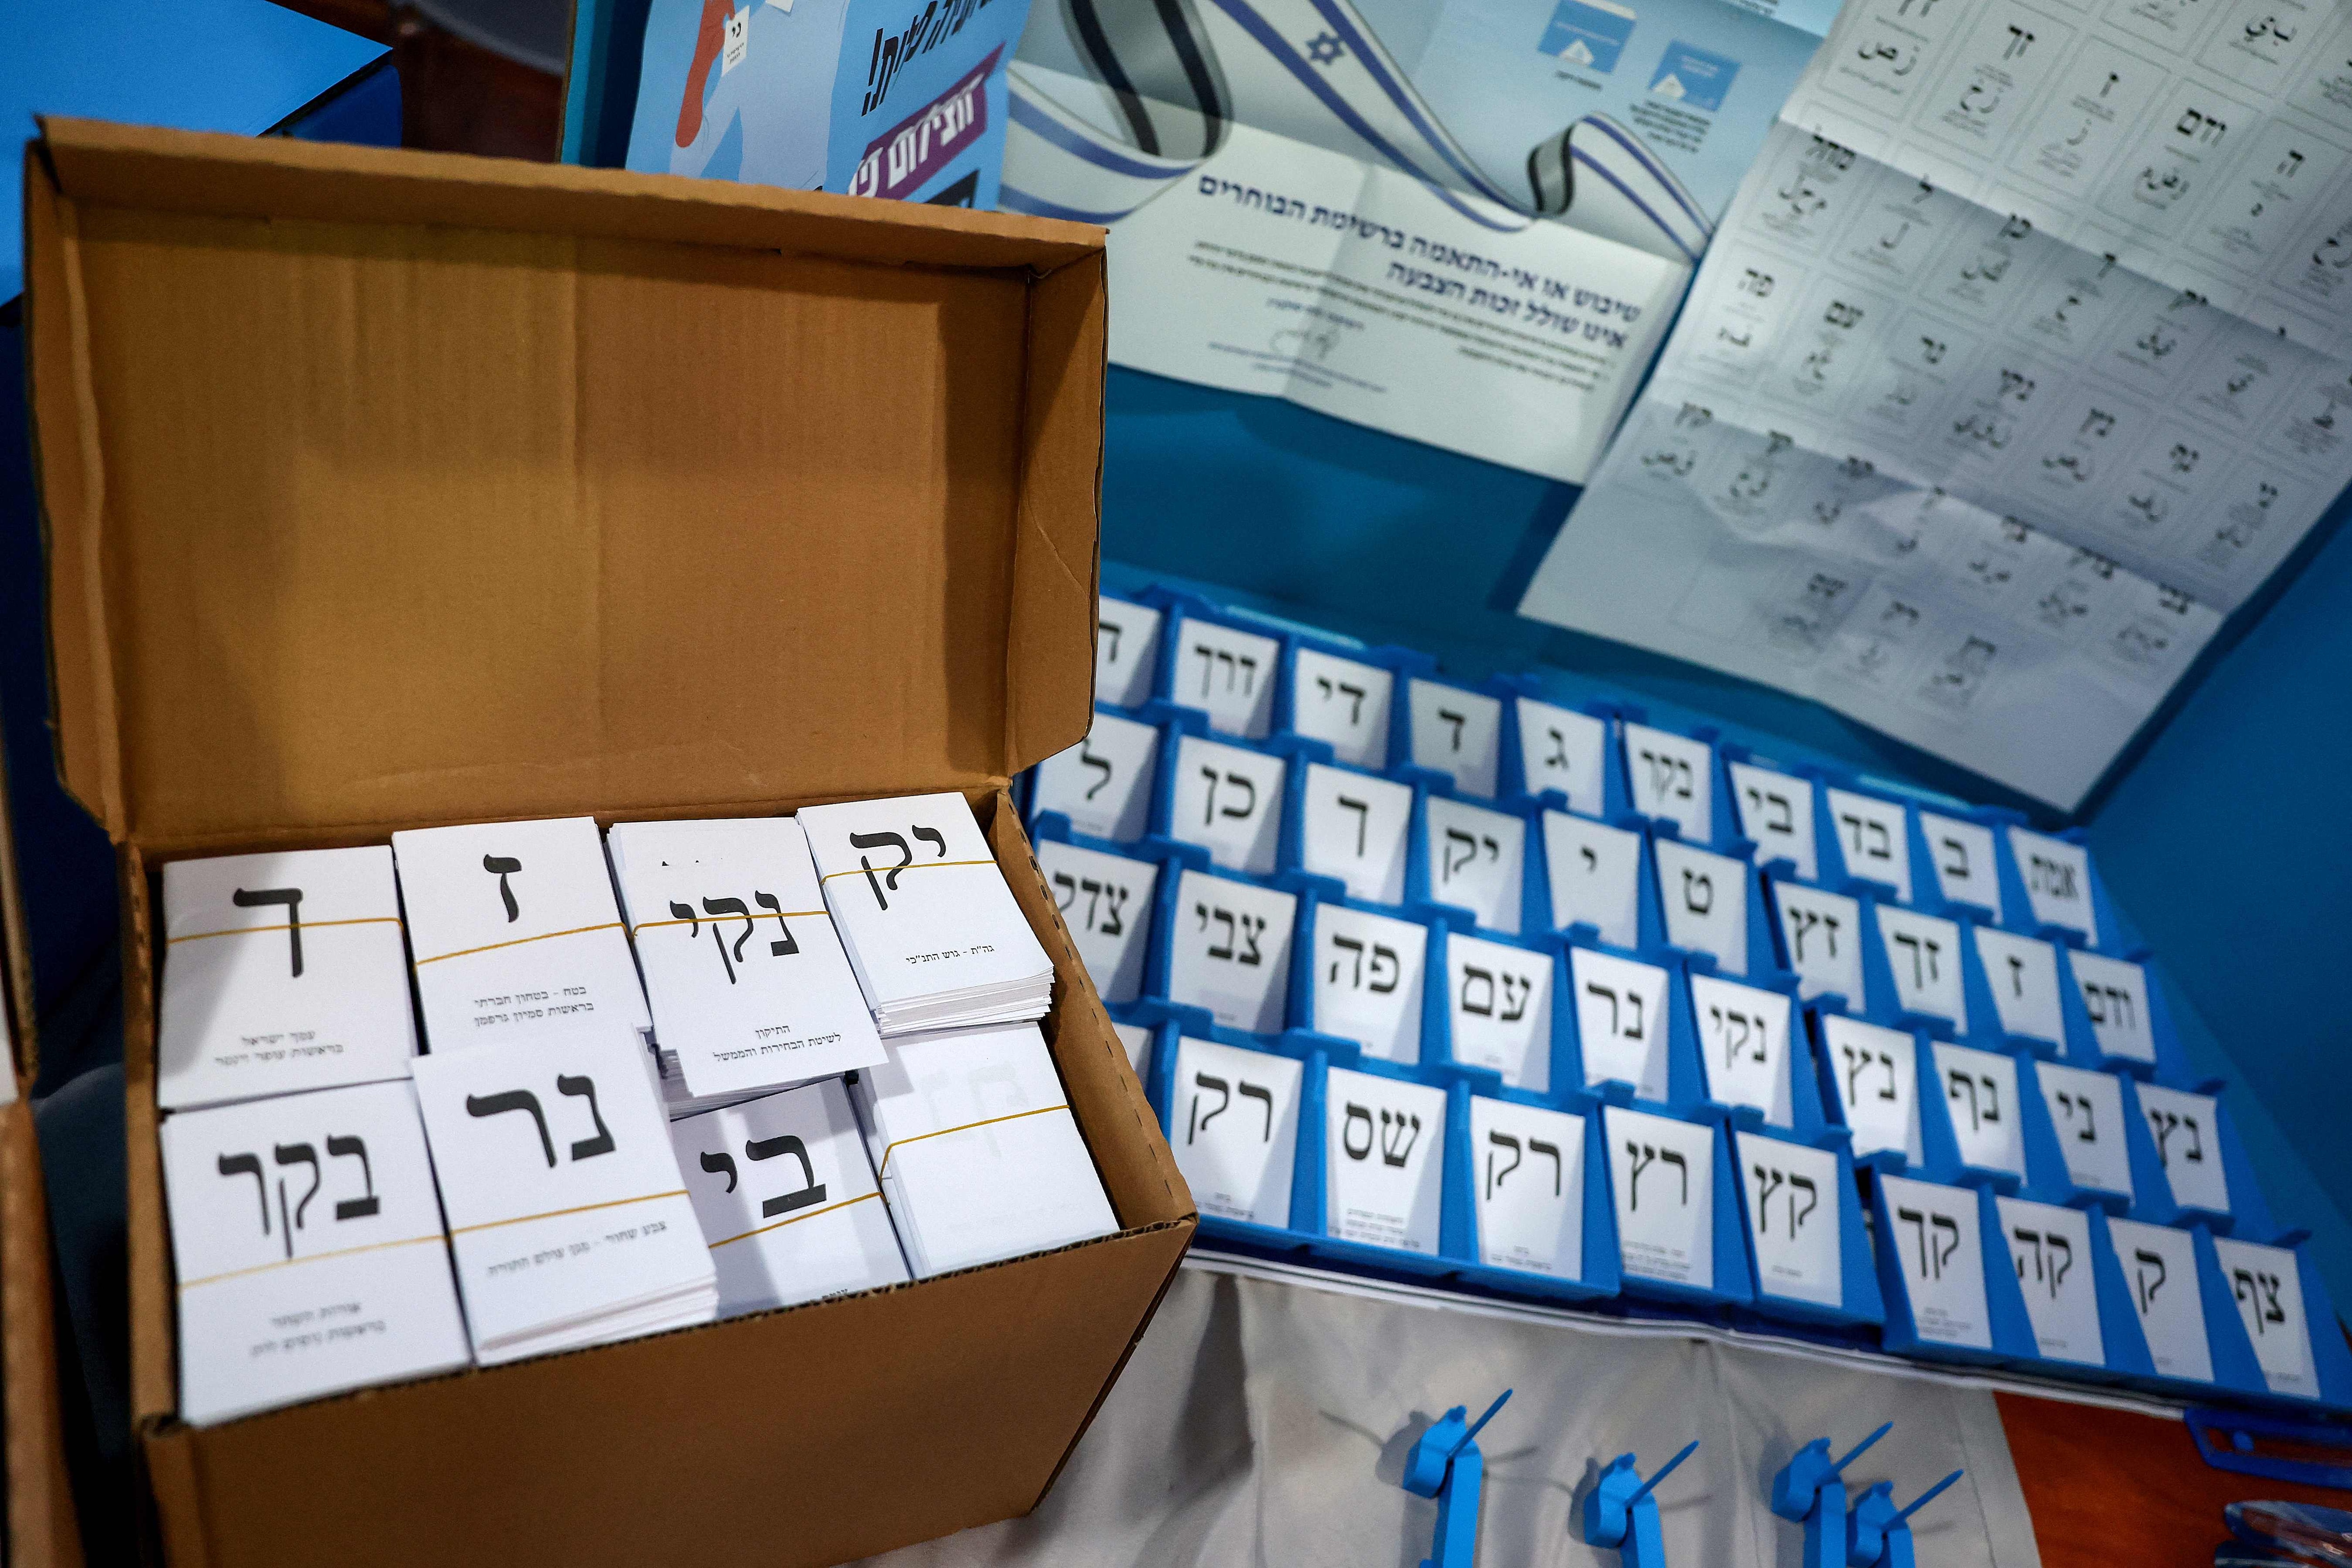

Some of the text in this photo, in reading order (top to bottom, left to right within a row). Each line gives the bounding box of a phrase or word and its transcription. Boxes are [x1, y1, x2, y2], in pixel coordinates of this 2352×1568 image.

[1198, 174, 1307, 221] הבוחרים
[1309, 204, 1406, 249] ברשימת
[1385, 261, 1629, 349] אינו שולל זכות הצבעה
[1543, 278, 1569, 300] או
[1574, 288, 1642, 324] שיבוש
[1317, 677, 1367, 726] די
[1081, 740, 1112, 800] ל
[1545, 728, 1567, 767] ג
[1201, 766, 1255, 825] כן
[1747, 788, 1794, 835] בי
[850, 826, 946, 910] יק
[1445, 827, 1499, 879] יק
[1581, 847, 1596, 869] י
[1943, 838, 1970, 879] ב
[484, 855, 521, 922] ז
[1683, 869, 1712, 915] ט
[670, 891, 799, 984] נקי
[905, 953, 940, 964] התנ"כי
[941, 950, 961, 959] גוש
[1196, 903, 1266, 967] צבי
[1788, 907, 1839, 962] זץ
[563, 986, 587, 996] בטח
[1329, 934, 1399, 994] פה
[1462, 964, 1531, 1022] עם
[2008, 956, 2023, 996] ז
[474, 996, 512, 1008] חברתי
[474, 1003, 594, 1027] בראשות סמיון גרפמן
[515, 991, 549, 1004] בטחון
[1587, 983, 1643, 1040] נר
[713, 1032, 841, 1062] לשיטת הבחירות והממשל
[755, 1024, 791, 1039] התיקון
[1710, 1006, 1766, 1068] נקי
[1843, 1045, 1896, 1106] נץ
[1948, 1069, 2000, 1130] נף
[467, 1075, 614, 1167] נר
[1187, 1072, 1272, 1146] רק
[1343, 1102, 1421, 1168] שס
[2057, 1092, 2096, 1143] ני
[700, 1135, 826, 1218] בי
[1487, 1130, 1561, 1200] רק
[1627, 1142, 1687, 1211] רץ
[218, 1137, 379, 1260] בקר
[1754, 1165, 1817, 1239] קץ
[1898, 1207, 1959, 1280] קך
[2014, 1228, 2072, 1297] קה
[2135, 1249, 2166, 1313] ק
[2233, 1268, 2285, 1333] צף
